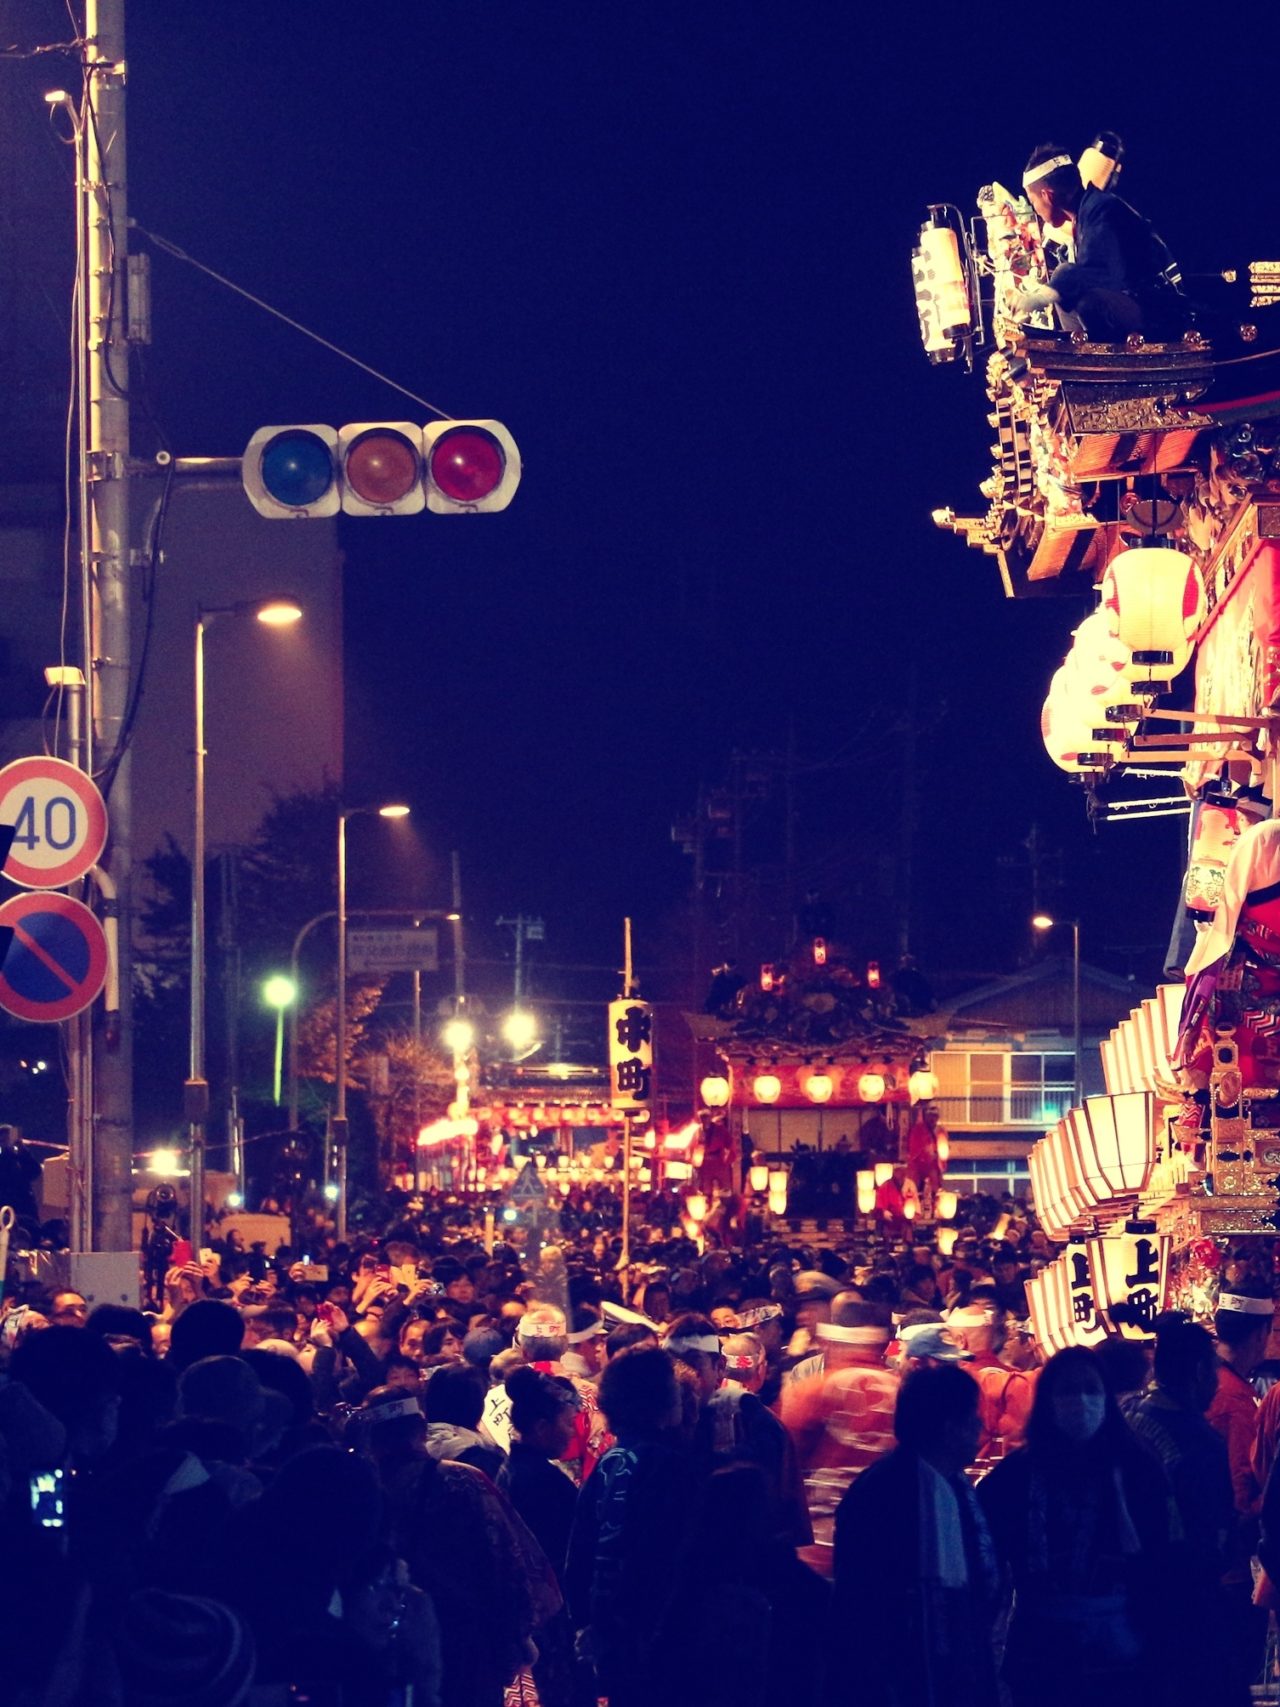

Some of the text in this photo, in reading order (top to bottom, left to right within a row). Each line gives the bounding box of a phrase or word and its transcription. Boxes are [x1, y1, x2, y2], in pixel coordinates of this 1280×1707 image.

[12, 796, 76, 850] 40
[1071, 1252, 1097, 1334] 上町
[1125, 1238, 1159, 1333] 上町
